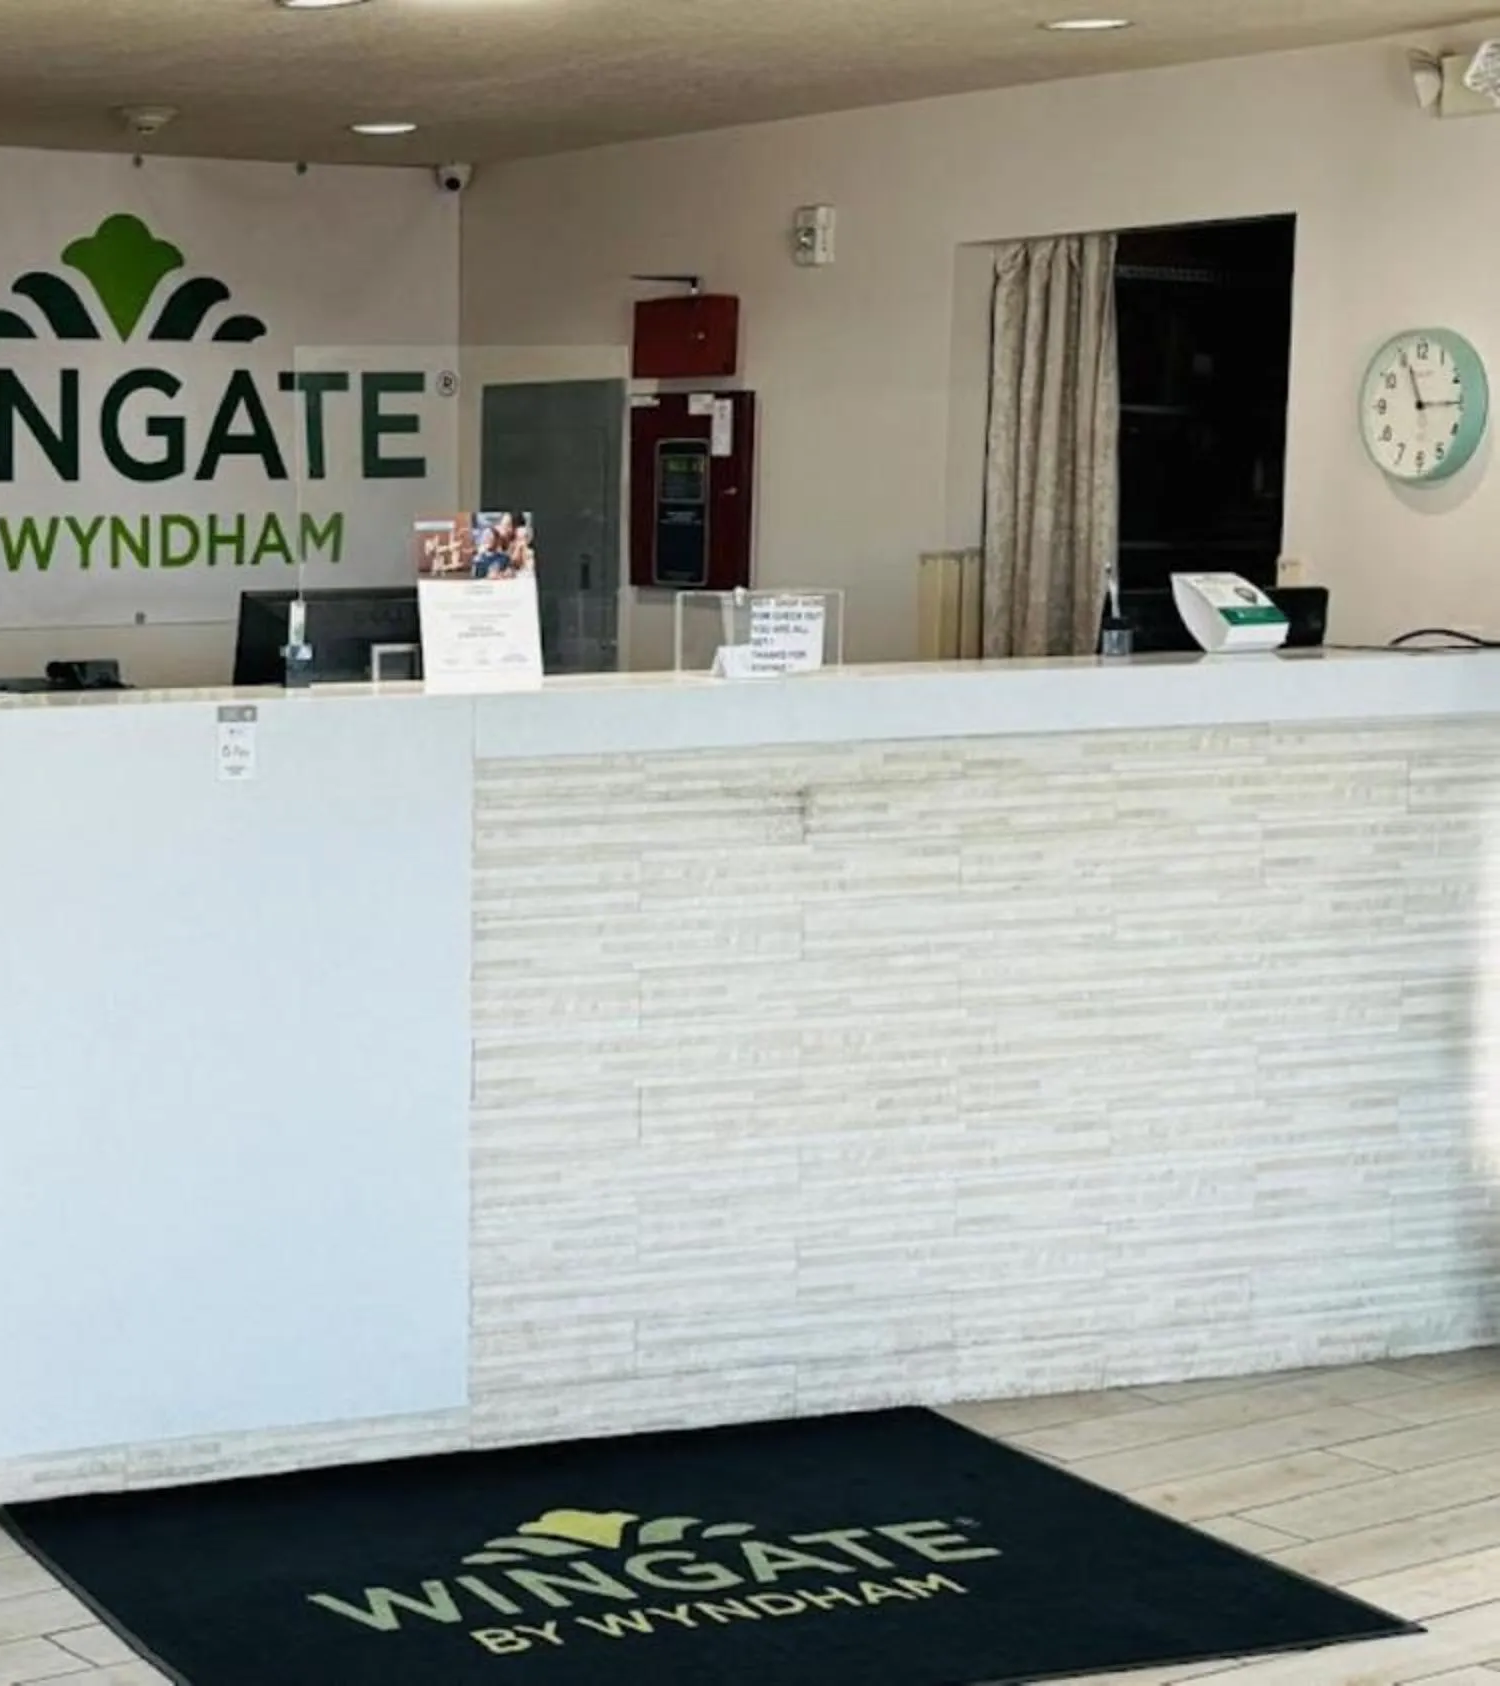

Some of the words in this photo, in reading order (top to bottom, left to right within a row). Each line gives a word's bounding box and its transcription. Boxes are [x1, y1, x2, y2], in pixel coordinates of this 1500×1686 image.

[1417, 341, 1428, 360] 12
[793, 624, 810, 634] ALL
[308, 1519, 1002, 1631] WINGATE
[470, 1620, 567, 1656] BY
[575, 1571, 969, 1638] WYNDHAM
